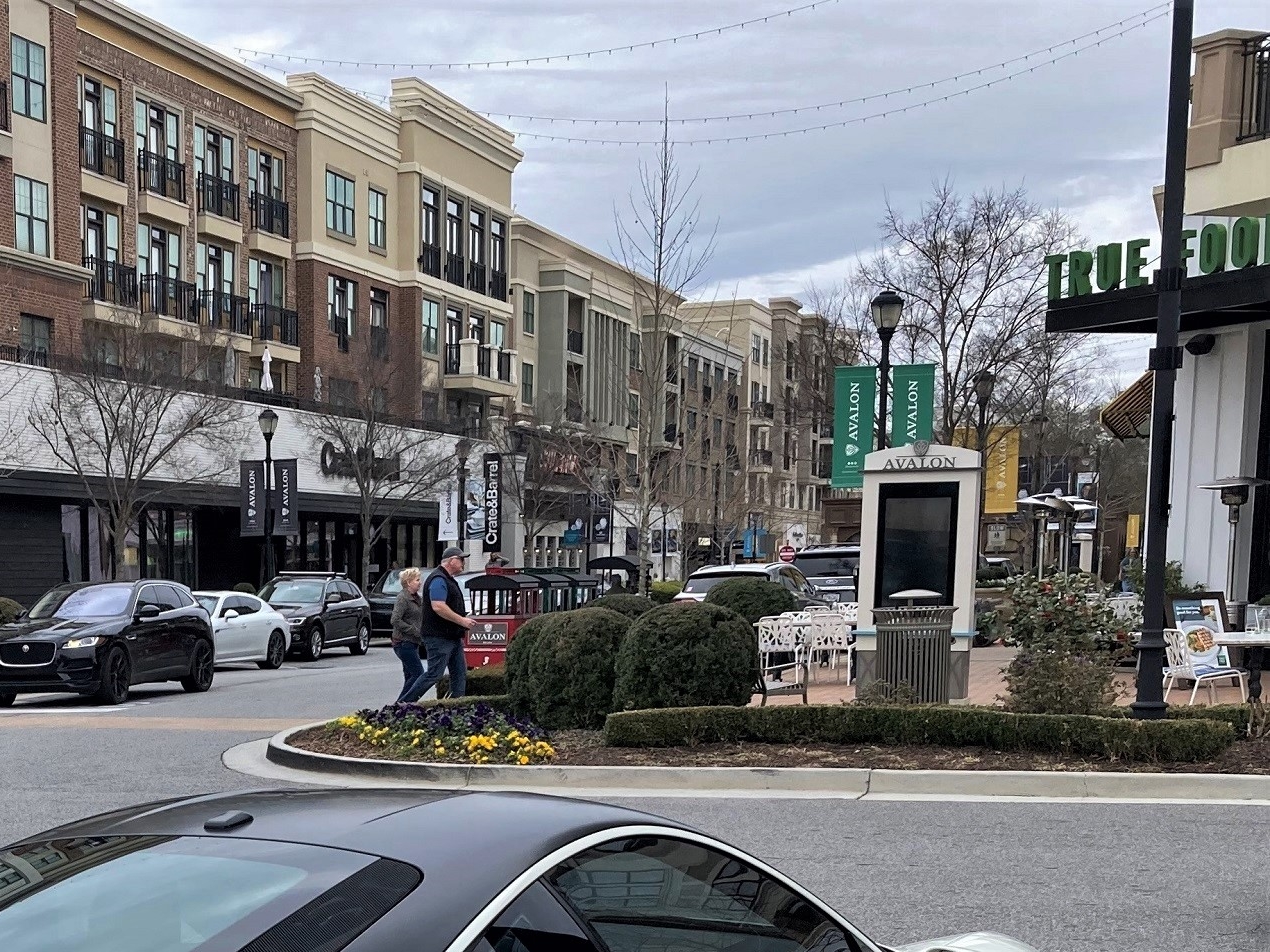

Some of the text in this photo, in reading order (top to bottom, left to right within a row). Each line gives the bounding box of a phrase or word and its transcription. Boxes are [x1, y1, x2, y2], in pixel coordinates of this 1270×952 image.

[1044, 213, 1270, 300] TRUE FOO
[848, 382, 860, 441] AVALON
[907, 380, 919, 439] AVALON
[248, 469, 256, 508] AVALON
[281, 468, 289, 506] AVALON
[883, 456, 957, 469] AVALON
[486, 460, 499, 545] Crate&Barrel
